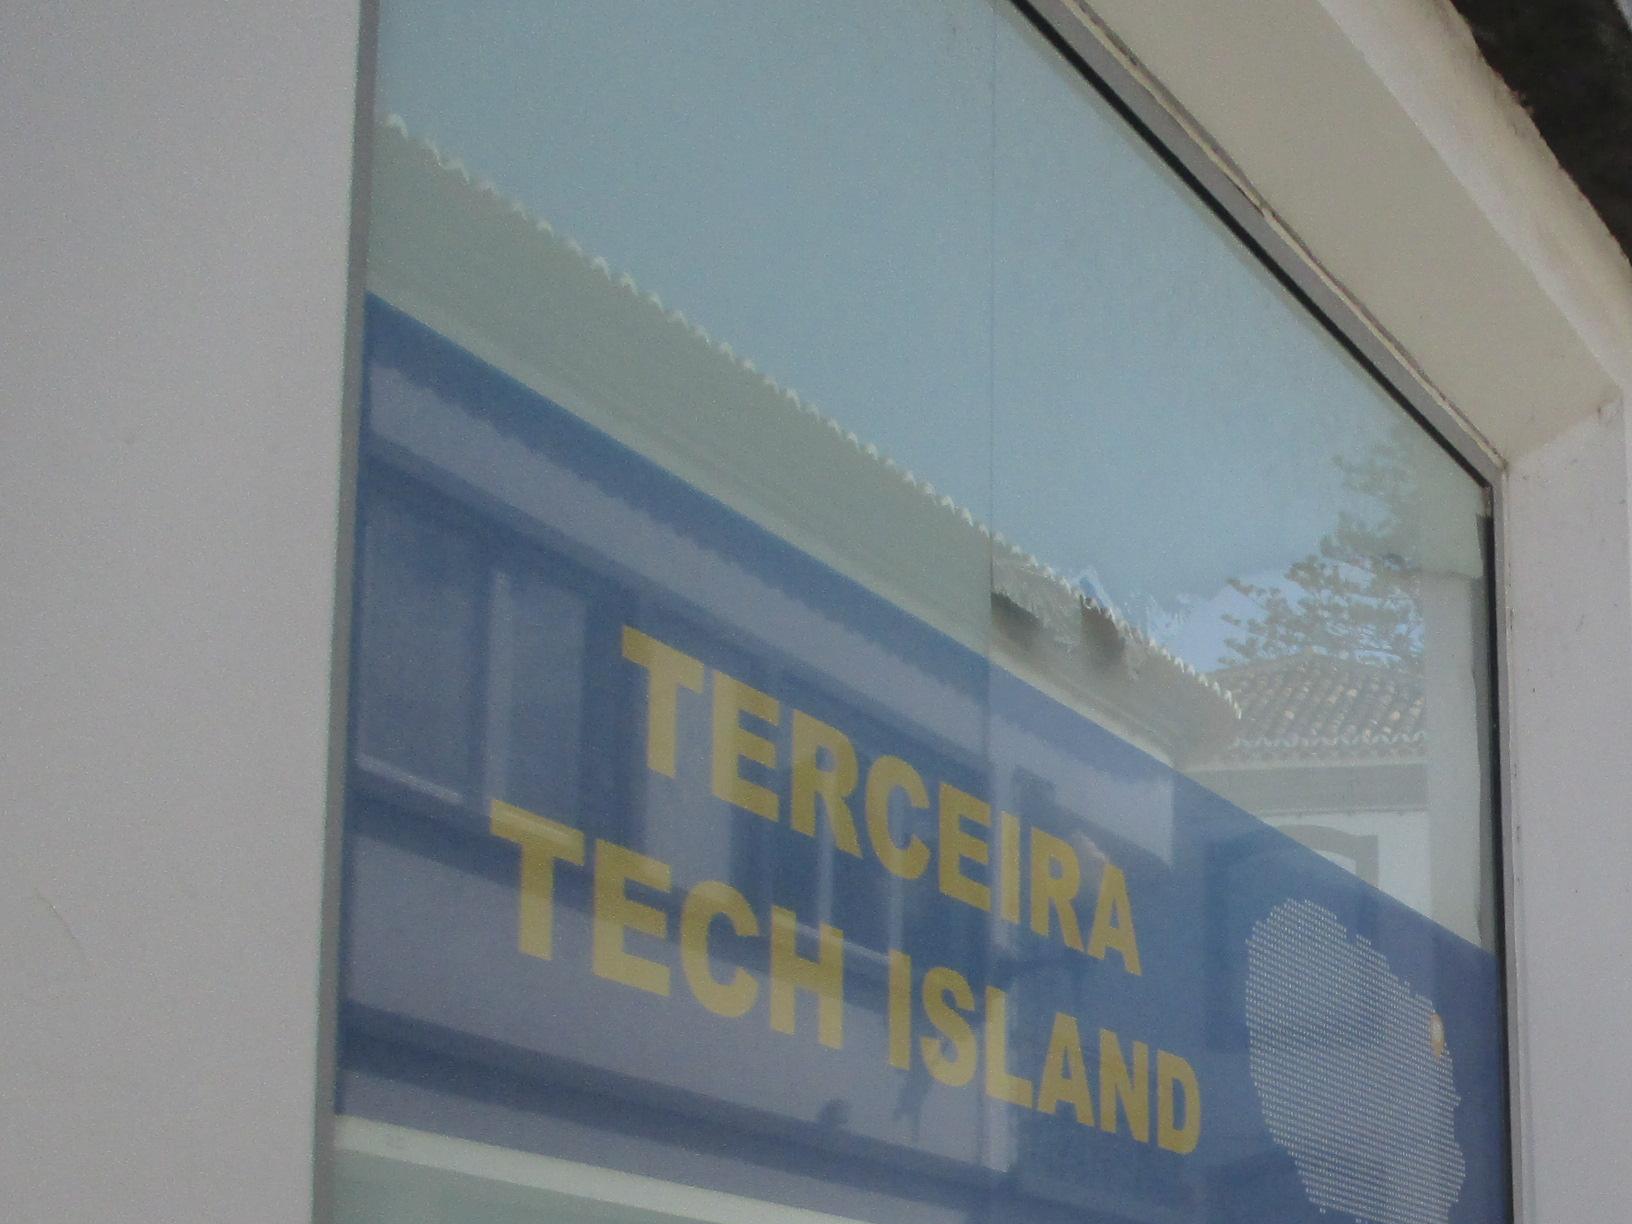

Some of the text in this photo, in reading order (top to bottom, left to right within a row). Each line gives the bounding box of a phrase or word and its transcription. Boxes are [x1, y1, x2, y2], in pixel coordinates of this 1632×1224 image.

[490, 799, 1200, 1155] TECH ISLAND
[622, 625, 1142, 976] TERCEIRA
